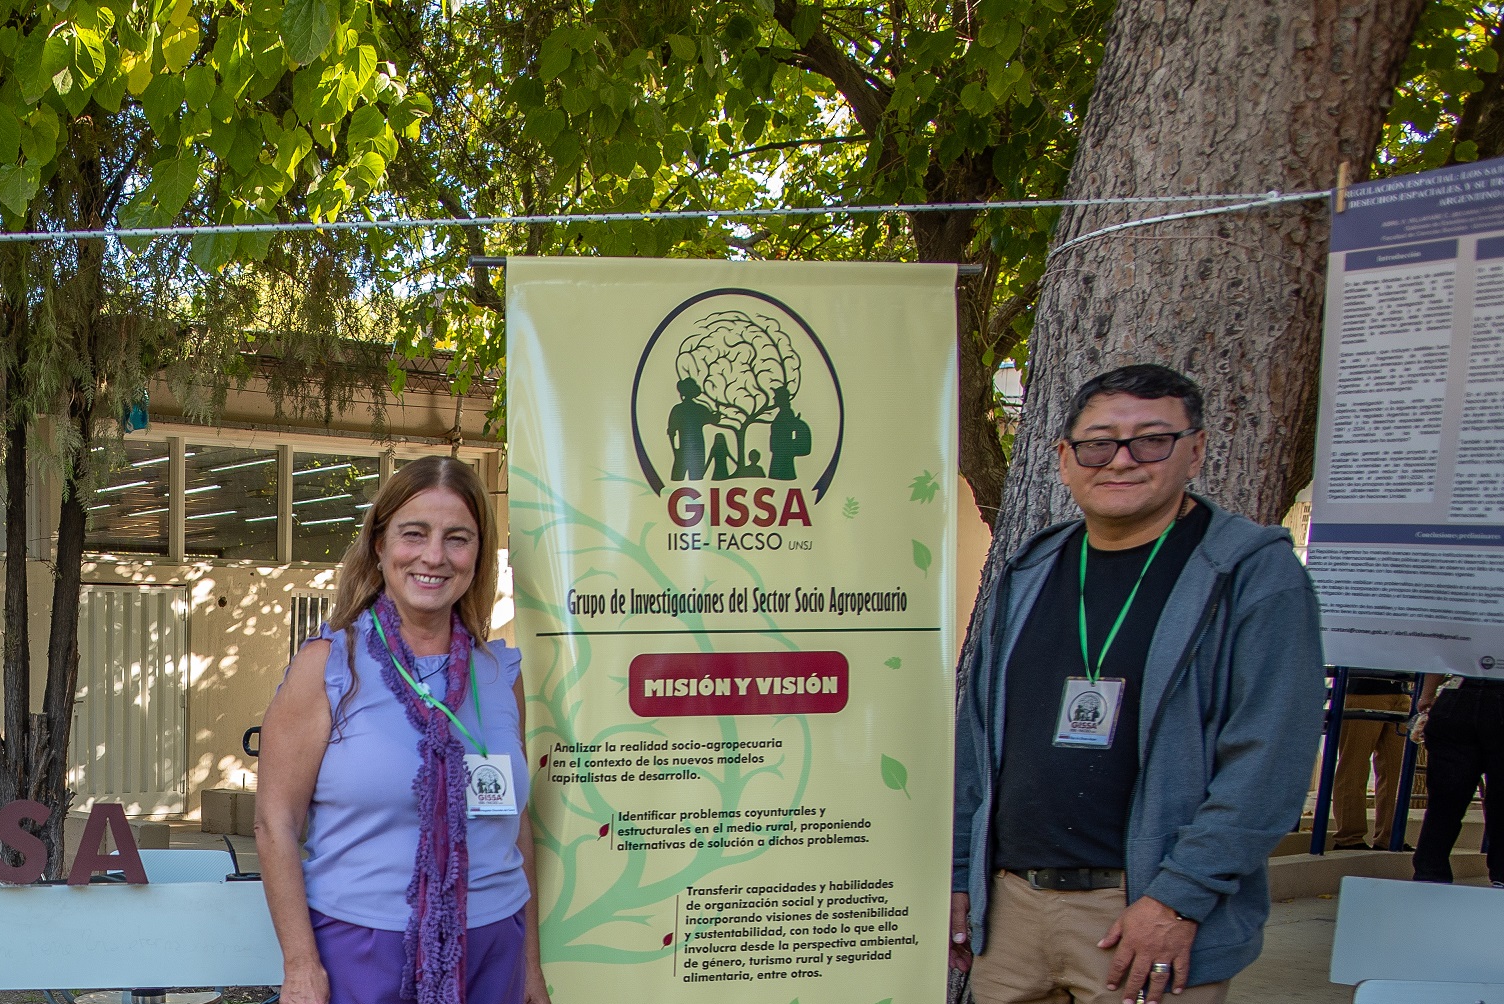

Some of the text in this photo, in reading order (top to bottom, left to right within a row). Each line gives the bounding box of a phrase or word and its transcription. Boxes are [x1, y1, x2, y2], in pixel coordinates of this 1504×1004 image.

[667, 487, 812, 528] GISSA
[668, 533, 812, 551] IISE- FACSO UNSJ
[567, 587, 907, 617] Grupo de Investigaciones del Sector Socio Agropecuario
[645, 673, 838, 697] MISIÓN Y VISIÓN
[554, 738, 782, 753] Analizar la realidad socio-agropecuaria
[553, 753, 764, 767] en el contexto de los nuevos modelos
[551, 770, 700, 785] capitalistas de desarrollo.
[618, 806, 826, 822] Identificar problemas coyunturales y
[617, 819, 871, 837] estructurales en el medio rural, proponiendo
[617, 834, 869, 850] alternativas de solución a dichos problemas.
[687, 879, 894, 896] Transferir capacidades y habilidades
[686, 894, 888, 911] de organización social y productiva,
[686, 907, 909, 926] incorporando visiones de sostenibilidad
[685, 922, 898, 941] y sustentabilidad, con todo lo que ello
[685, 935, 918, 954] involucra desde la perspectiva ambiental,
[684, 950, 892, 970] de género, turismo rural y seguridad
[683, 968, 822, 983] alimentaria, entre otros.
